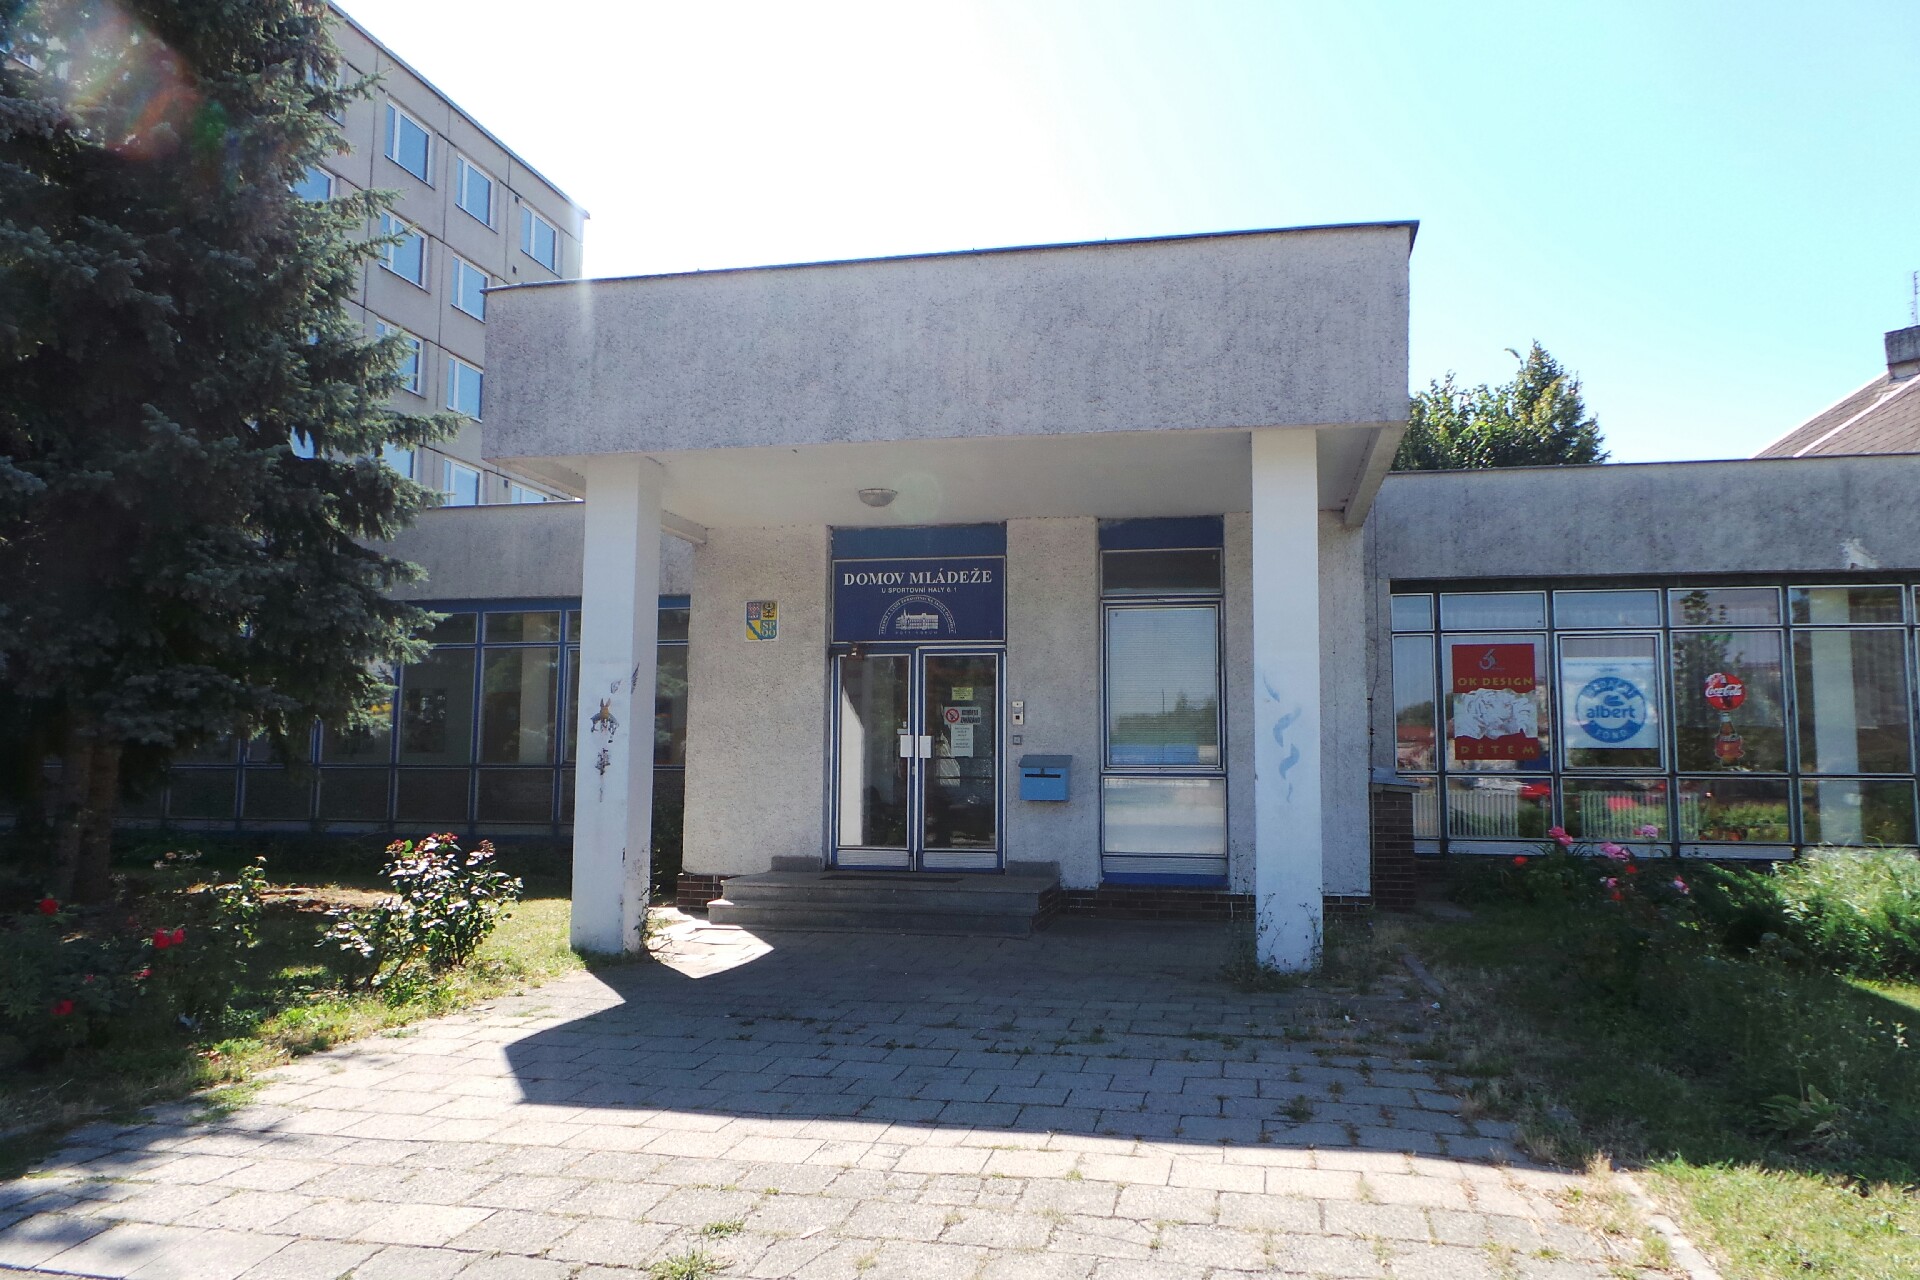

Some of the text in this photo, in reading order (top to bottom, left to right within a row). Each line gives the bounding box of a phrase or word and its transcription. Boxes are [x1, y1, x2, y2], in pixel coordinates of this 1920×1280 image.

[843, 567, 993, 586] DOMOV MLÁDEŽE
[1457, 677, 1533, 686] OK DESIGN
[1586, 704, 1636, 719] albert
